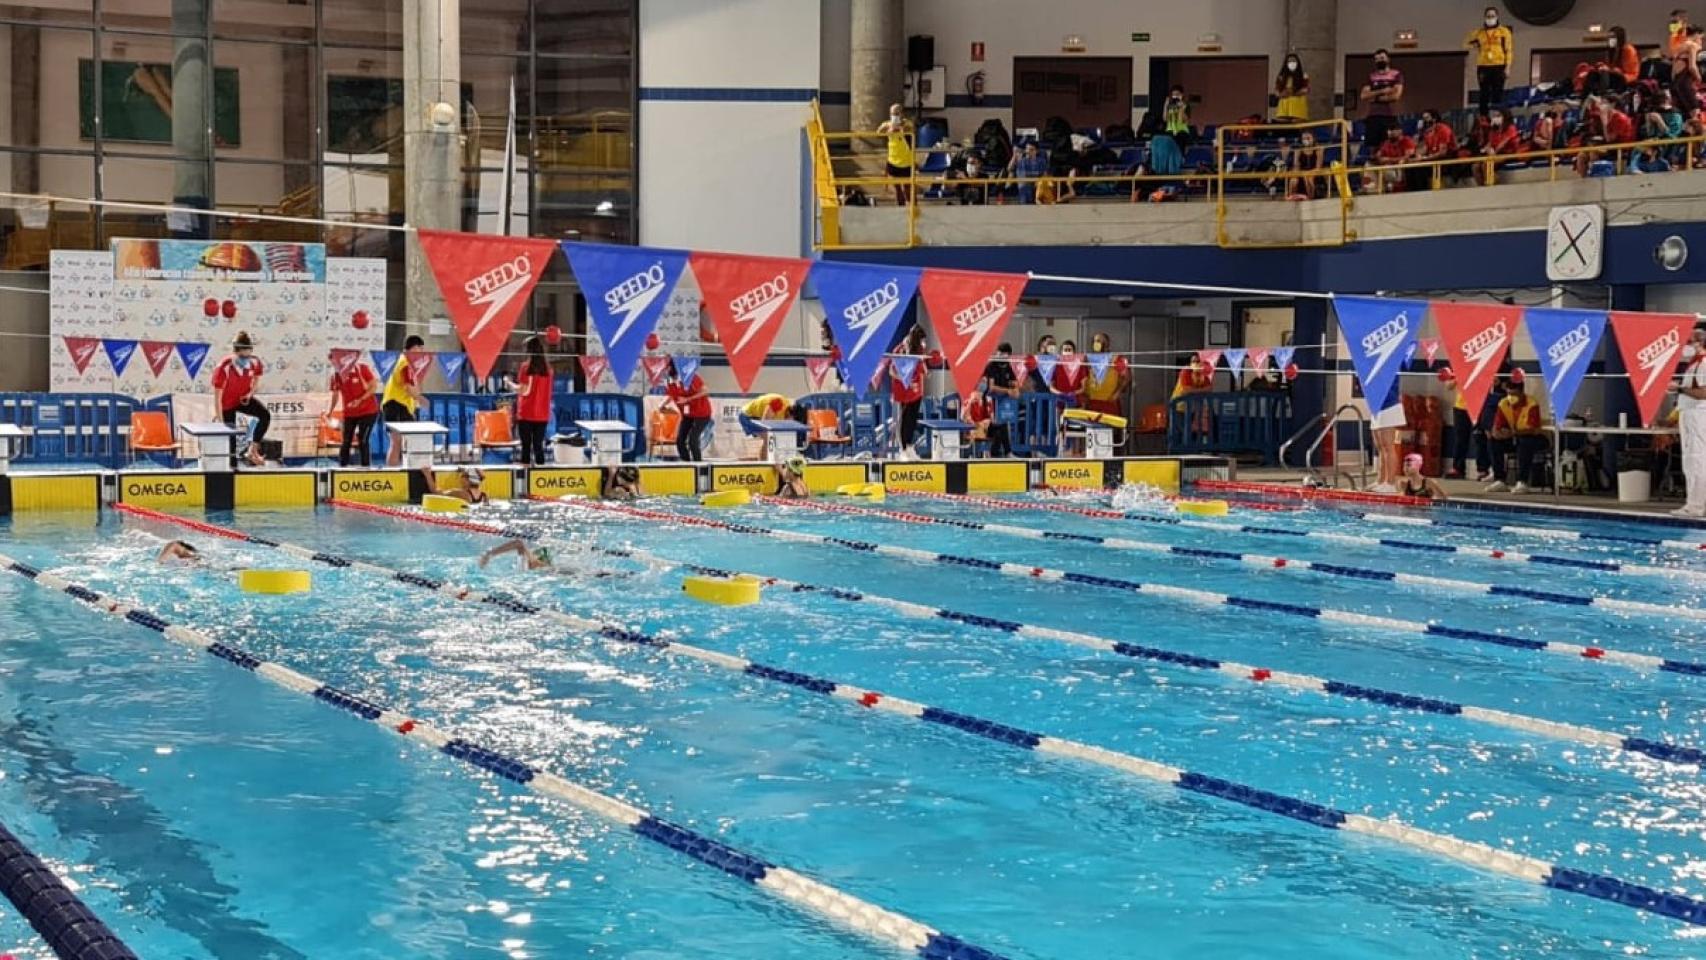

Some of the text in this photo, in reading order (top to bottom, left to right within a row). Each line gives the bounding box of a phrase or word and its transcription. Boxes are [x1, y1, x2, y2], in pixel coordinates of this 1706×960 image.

[464, 255, 531, 301] SPEEDO
[604, 265, 664, 311] SPEEDO
[729, 275, 788, 319] SPEEDO
[843, 282, 898, 326] SPEEDO
[953, 290, 1006, 331] SPEEDO
[1362, 314, 1408, 354] SPEEDO
[1462, 321, 1506, 358] SPEEDO
[1548, 324, 1589, 362] SPEEDO
[1636, 329, 1679, 367] SPEEDO
[267, 402, 304, 413] RFESS
[128, 483, 187, 496] OMEGA
[339, 480, 393, 492] OMEGA
[535, 477, 587, 488] OMEGA
[717, 474, 765, 486] OMEGA
[889, 470, 933, 482] OMEGA
[1049, 468, 1091, 480] OMEGA
